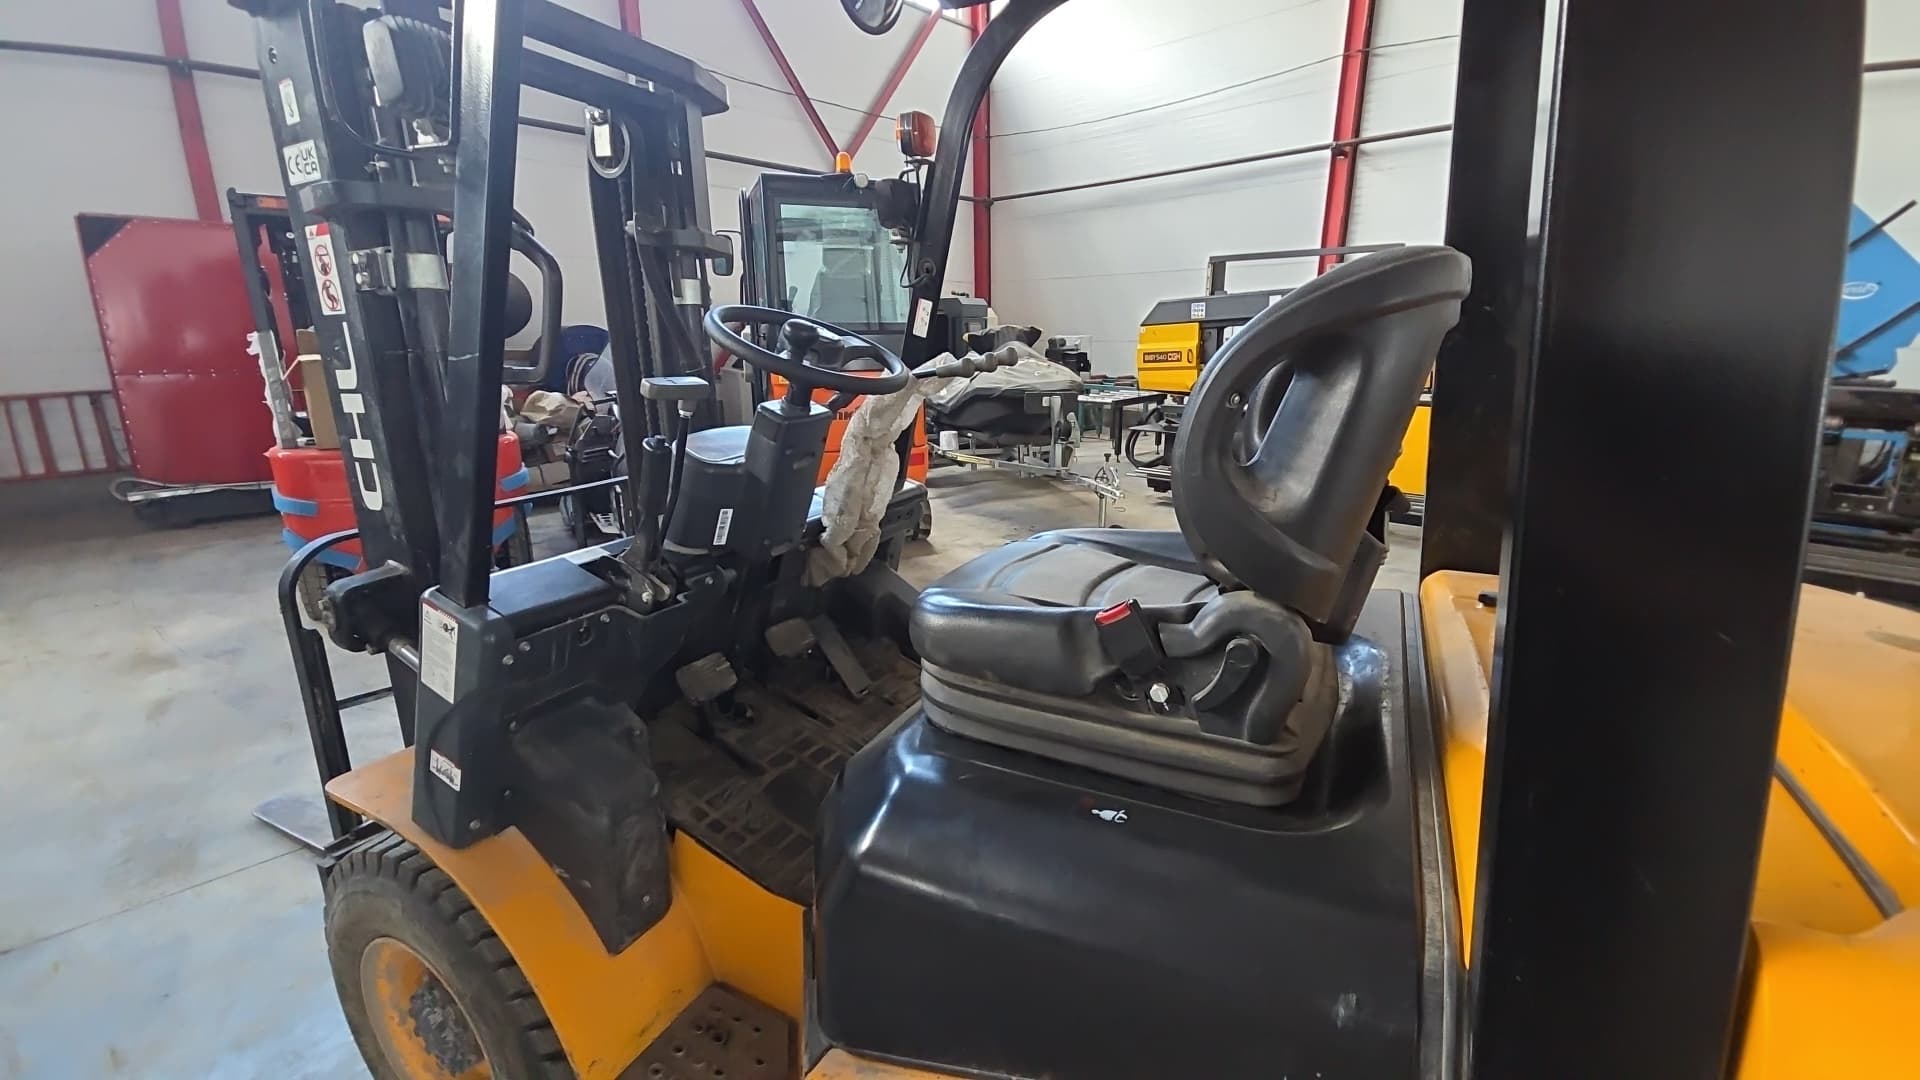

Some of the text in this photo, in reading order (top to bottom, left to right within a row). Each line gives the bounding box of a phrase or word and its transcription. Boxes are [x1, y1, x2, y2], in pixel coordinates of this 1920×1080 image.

[300, 147, 314, 161] UK
[288, 154, 303, 175] CE
[304, 161, 318, 175] CA
[1156, 353, 1167, 361] 540
[335, 321, 383, 511] CHL
